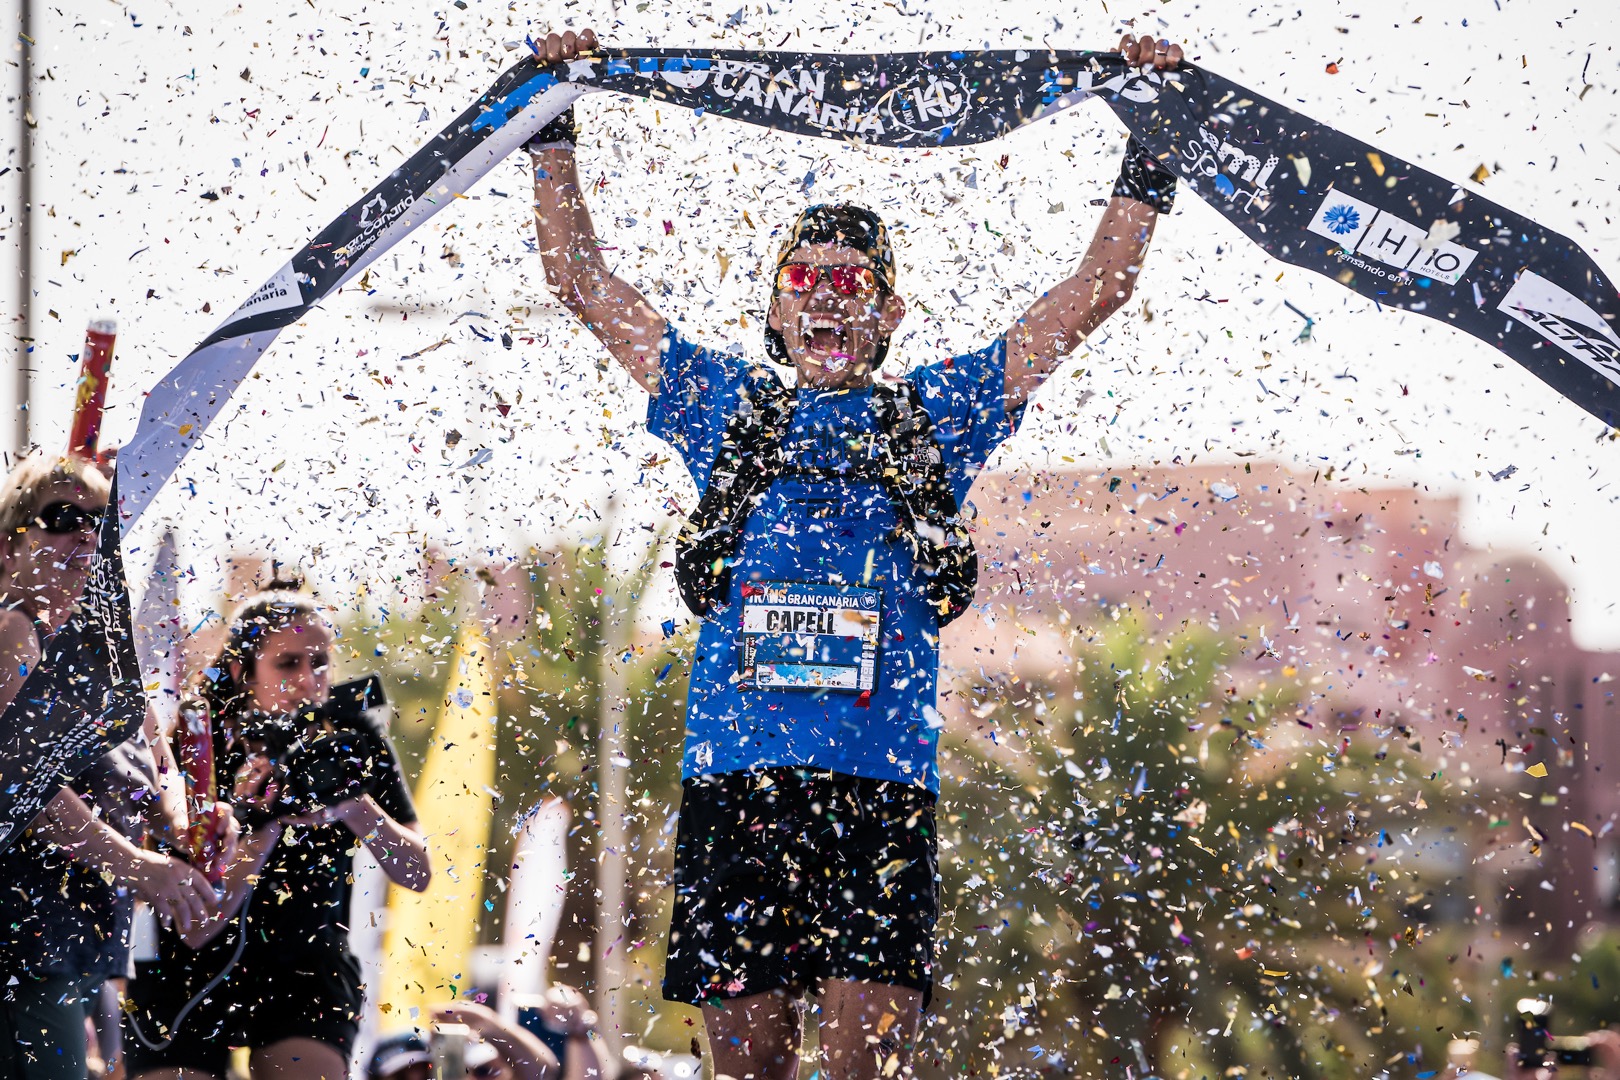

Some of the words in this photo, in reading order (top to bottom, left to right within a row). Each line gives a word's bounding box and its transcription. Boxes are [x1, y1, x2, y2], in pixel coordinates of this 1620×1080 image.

[713, 71, 885, 135] CANARIA
[363, 194, 415, 236] Canaria
[1333, 250, 1386, 277] Pensando
[1388, 272, 1402, 283] en
[1404, 276, 1415, 286] ti
[1420, 266, 1450, 280] HOTELS
[767, 610, 835, 634] CAPELL
[796, 633, 815, 661] 1
